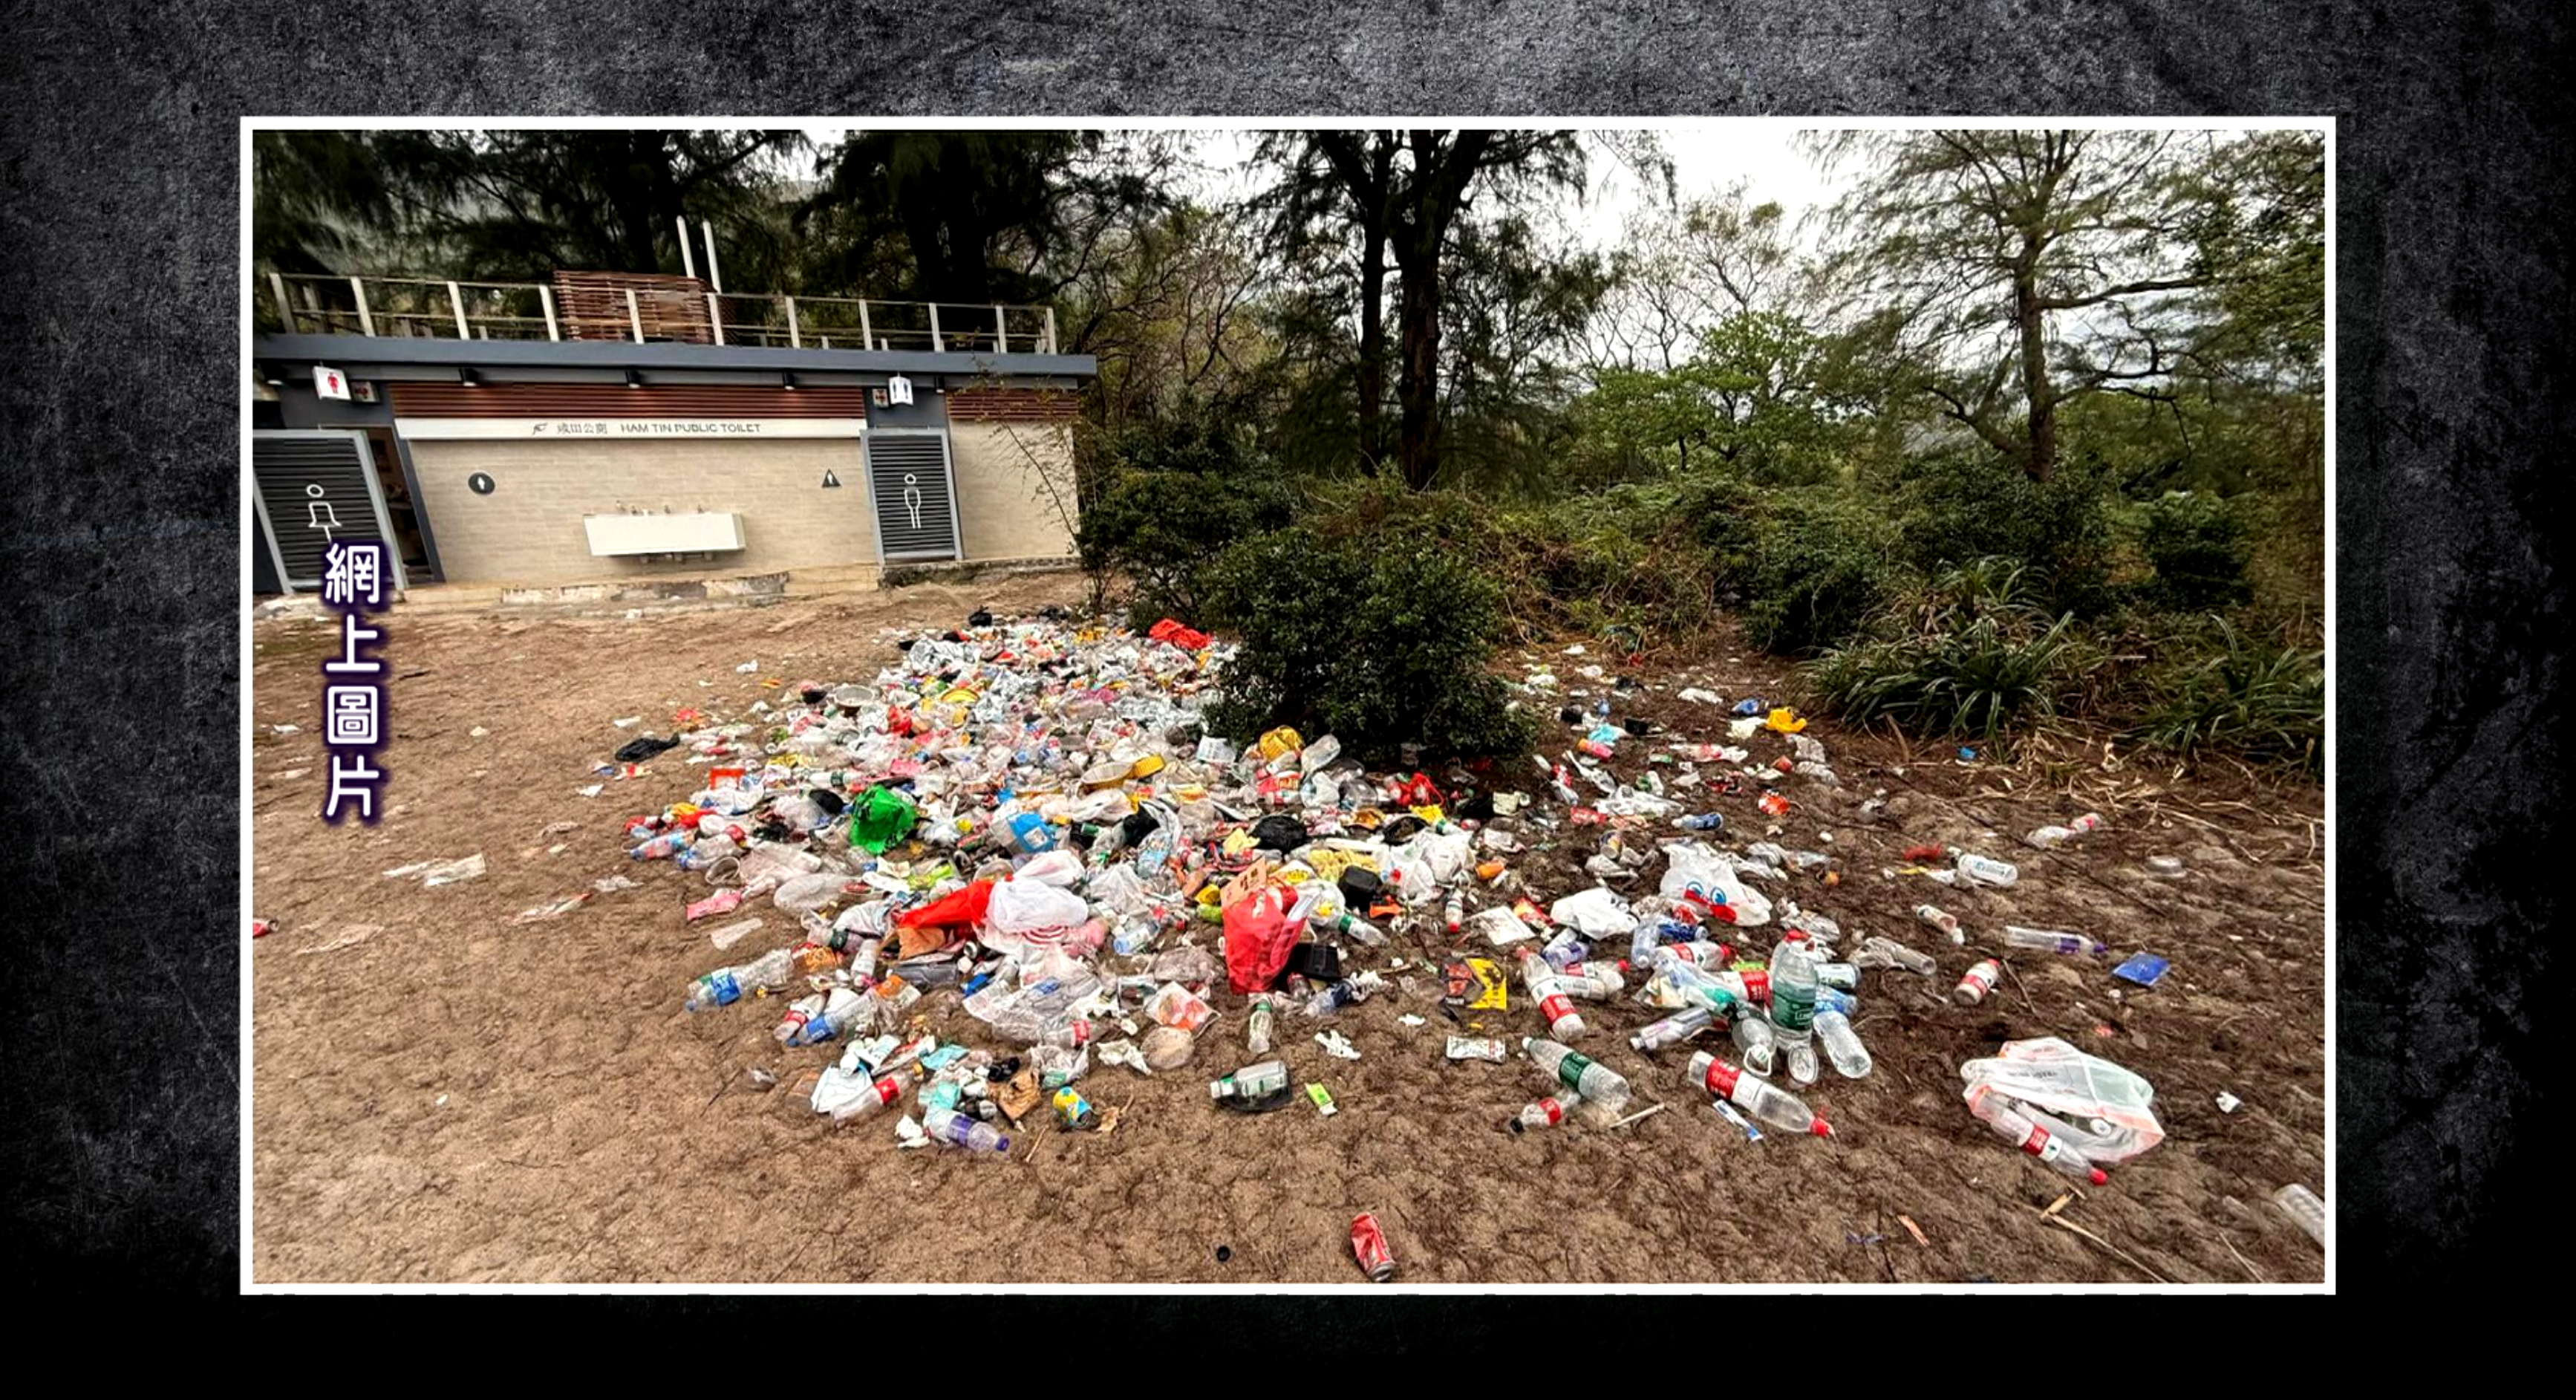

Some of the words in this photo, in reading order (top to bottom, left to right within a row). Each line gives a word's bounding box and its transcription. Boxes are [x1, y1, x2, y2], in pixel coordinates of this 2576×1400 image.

[621, 423, 649, 433] HAM
[651, 423, 672, 433] TIN
[674, 423, 717, 433] PUBLIC
[720, 423, 761, 433] TOILET
